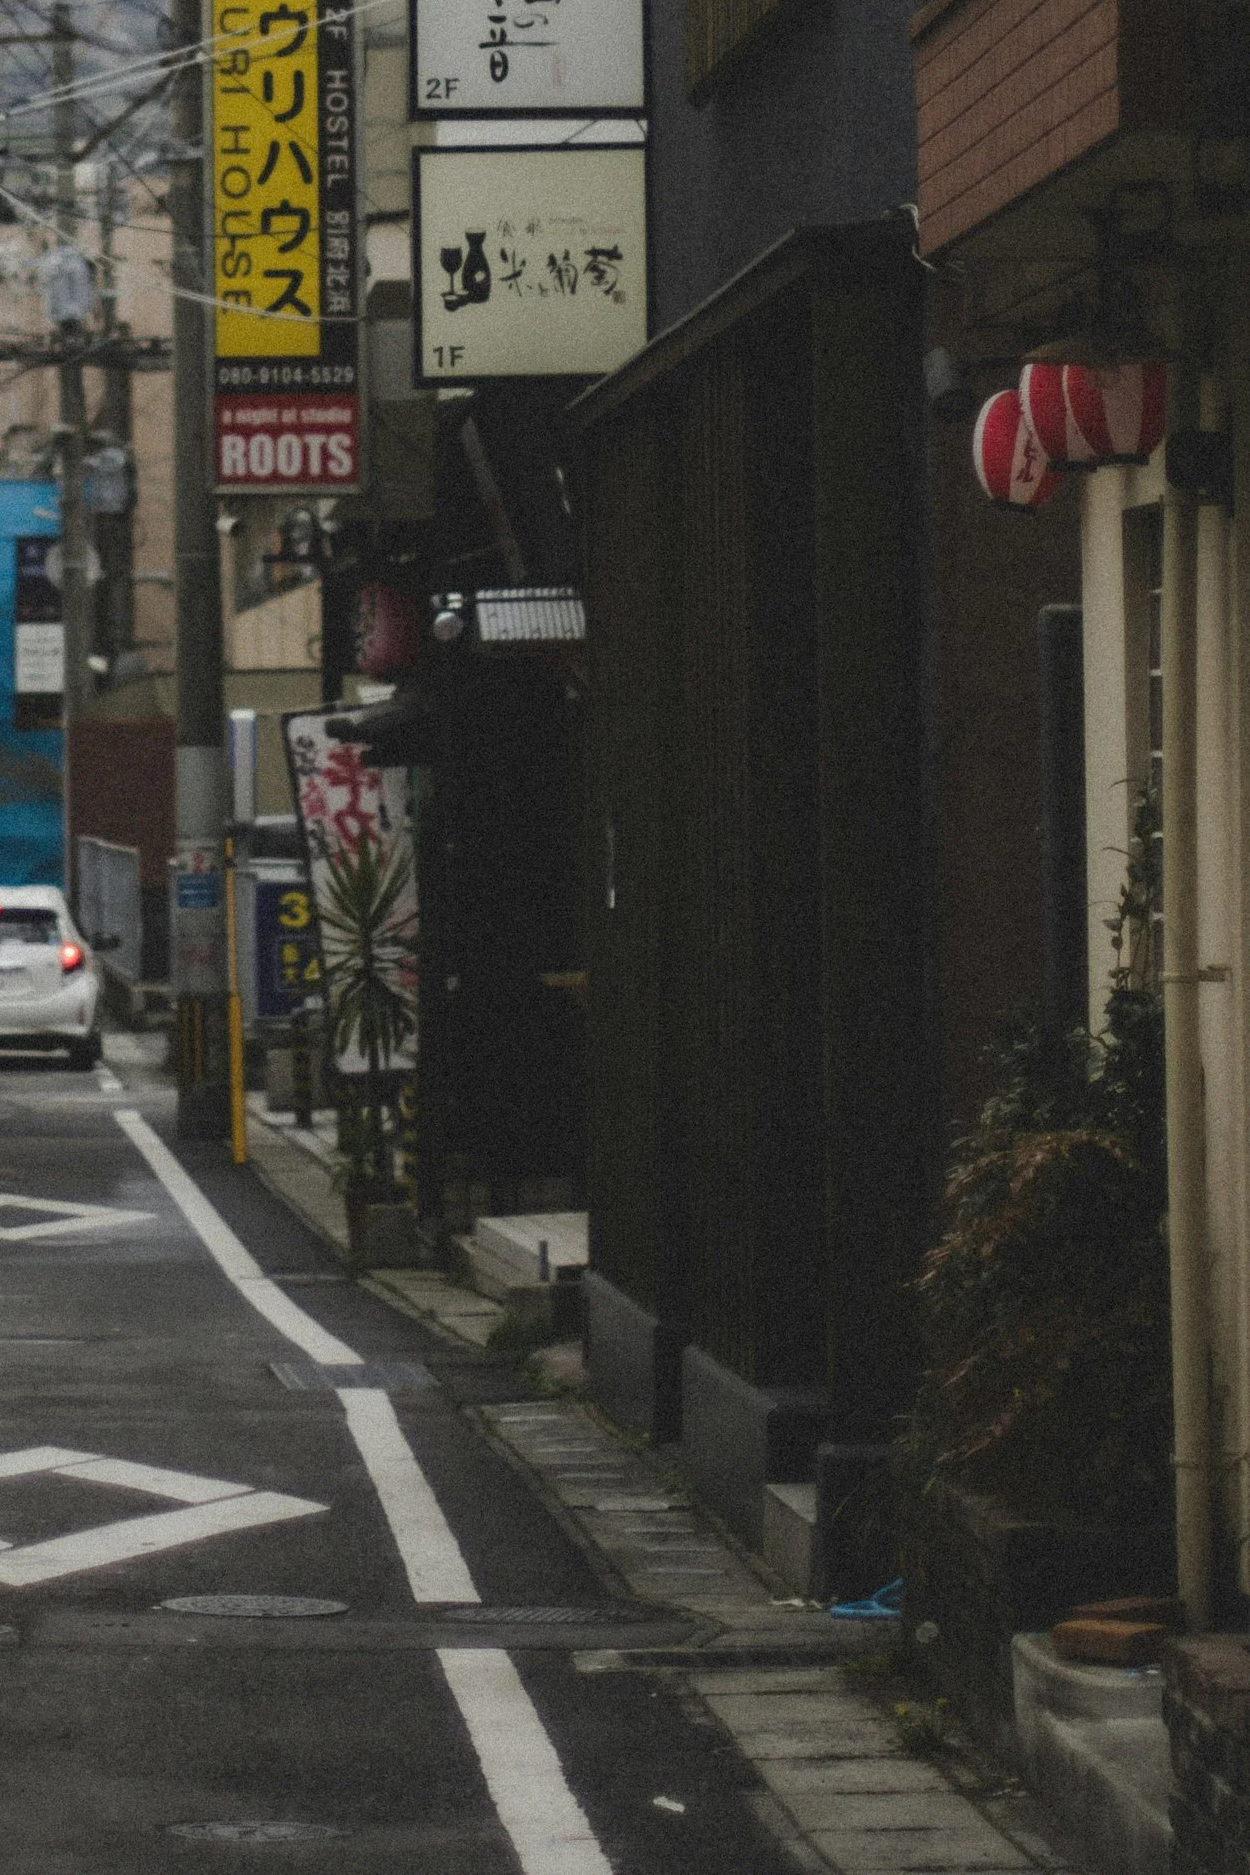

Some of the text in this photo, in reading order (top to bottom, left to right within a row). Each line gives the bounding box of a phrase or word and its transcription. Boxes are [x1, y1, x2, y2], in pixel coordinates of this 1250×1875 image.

[324, 68, 351, 189] HOSTEL
[425, 77, 460, 100] 2F
[219, 7, 254, 315] URI HOUSE
[257, 2, 314, 317] ウリハウス
[432, 346, 466, 368] 1F
[220, 433, 354, 478] ROOTS
